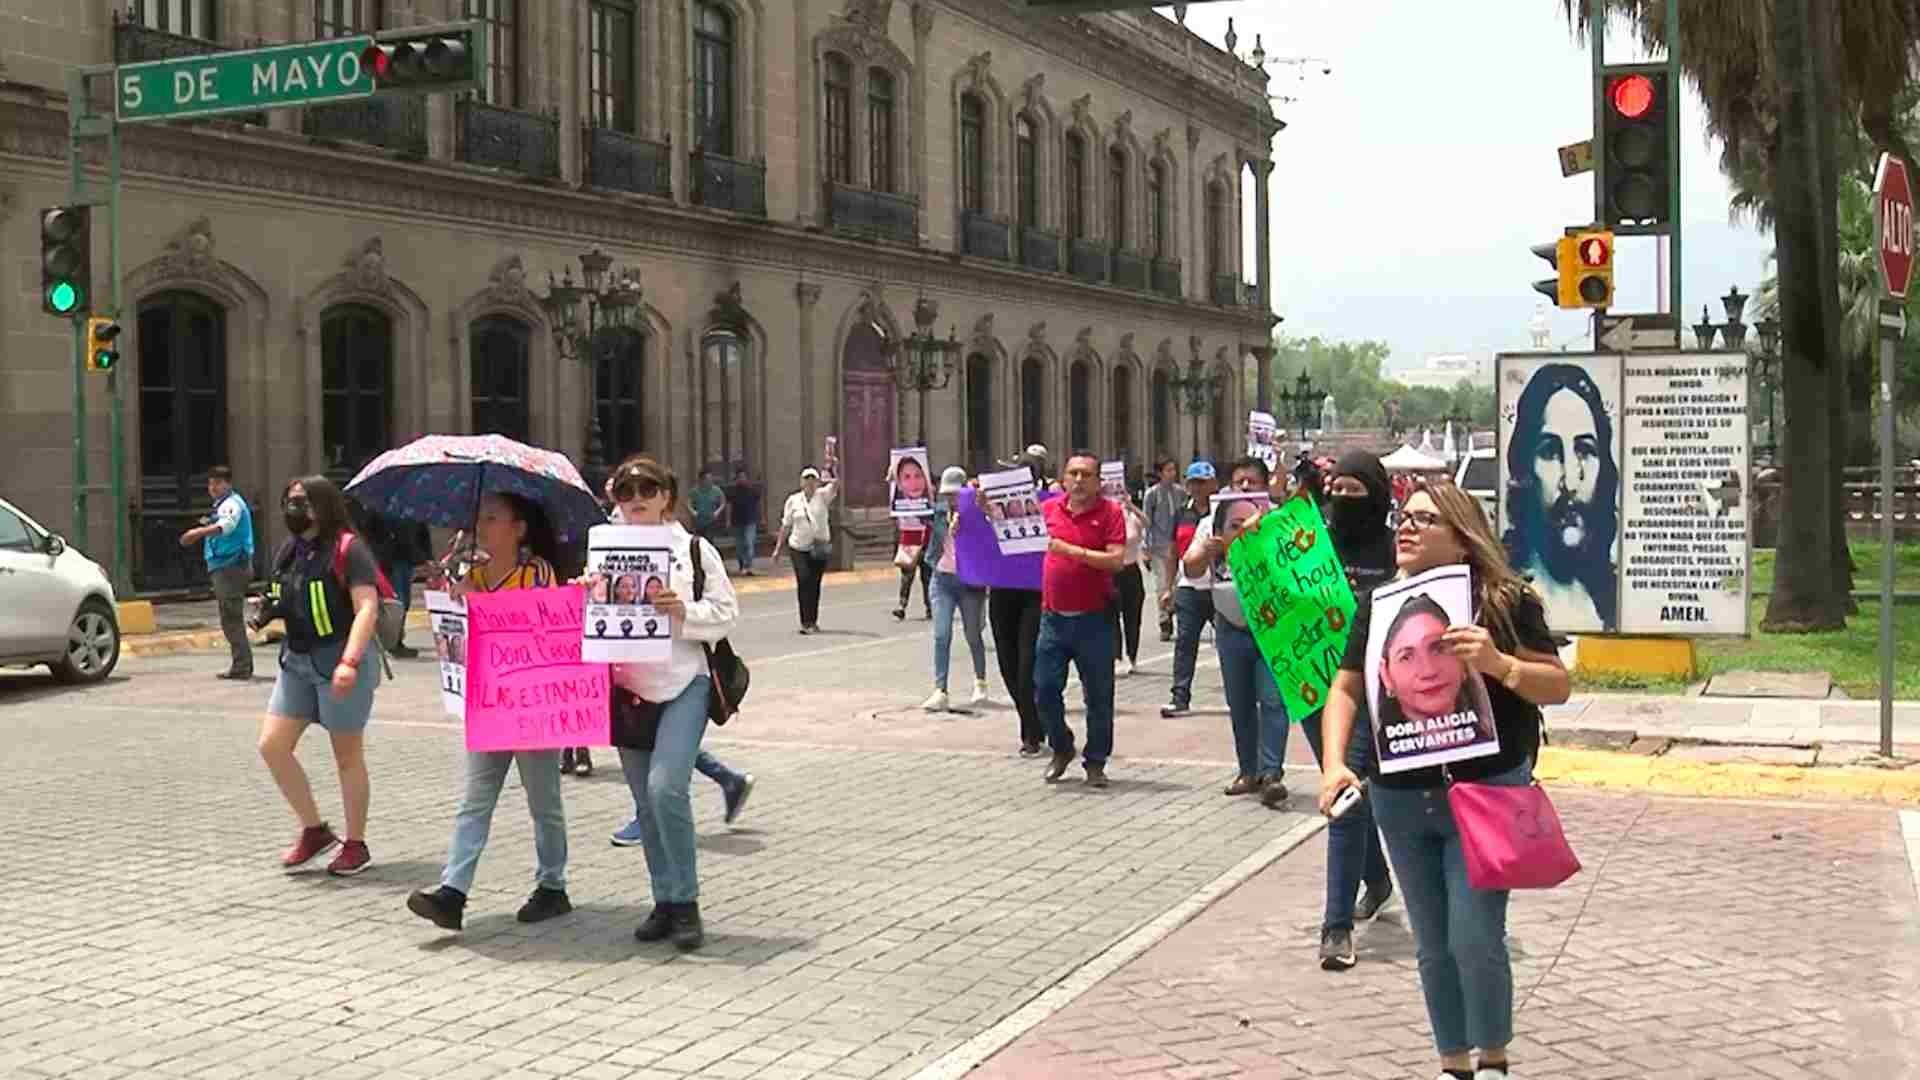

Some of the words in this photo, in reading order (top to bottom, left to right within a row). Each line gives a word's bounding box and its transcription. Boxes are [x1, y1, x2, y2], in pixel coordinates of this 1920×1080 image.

[123, 75, 142, 108] 5
[173, 67, 220, 104] DE
[252, 51, 361, 96] MAYO
[1882, 199, 1912, 256] ALTO
[1291, 558, 1340, 592] hoy
[1660, 607, 1709, 621] AMEN.
[490, 642, 535, 668] Dora
[1385, 721, 1424, 739] DORA
[1426, 711, 1478, 731] ALICIA
[1389, 726, 1476, 754] CERVANTES
